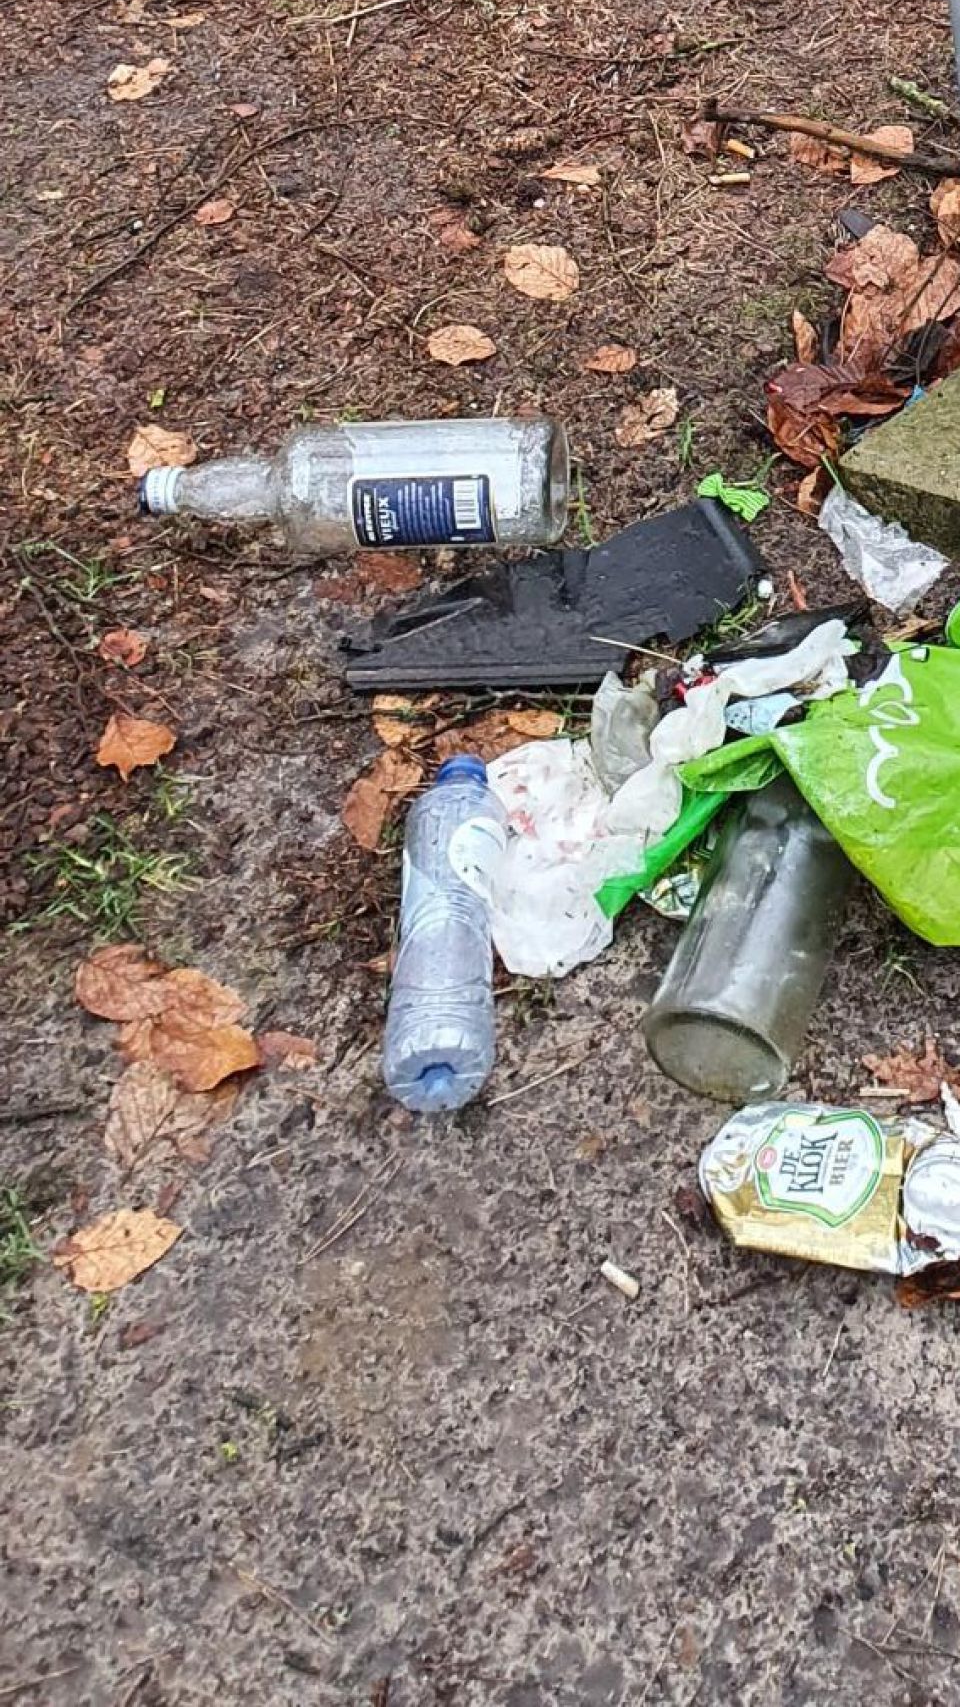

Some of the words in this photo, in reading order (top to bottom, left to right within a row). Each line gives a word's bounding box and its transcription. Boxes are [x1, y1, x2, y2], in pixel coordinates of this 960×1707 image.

[379, 496, 394, 542] VIEUX
[779, 1147, 800, 1175] DE
[786, 1131, 839, 1194] KLOK
[829, 1138, 854, 1185] BIER
